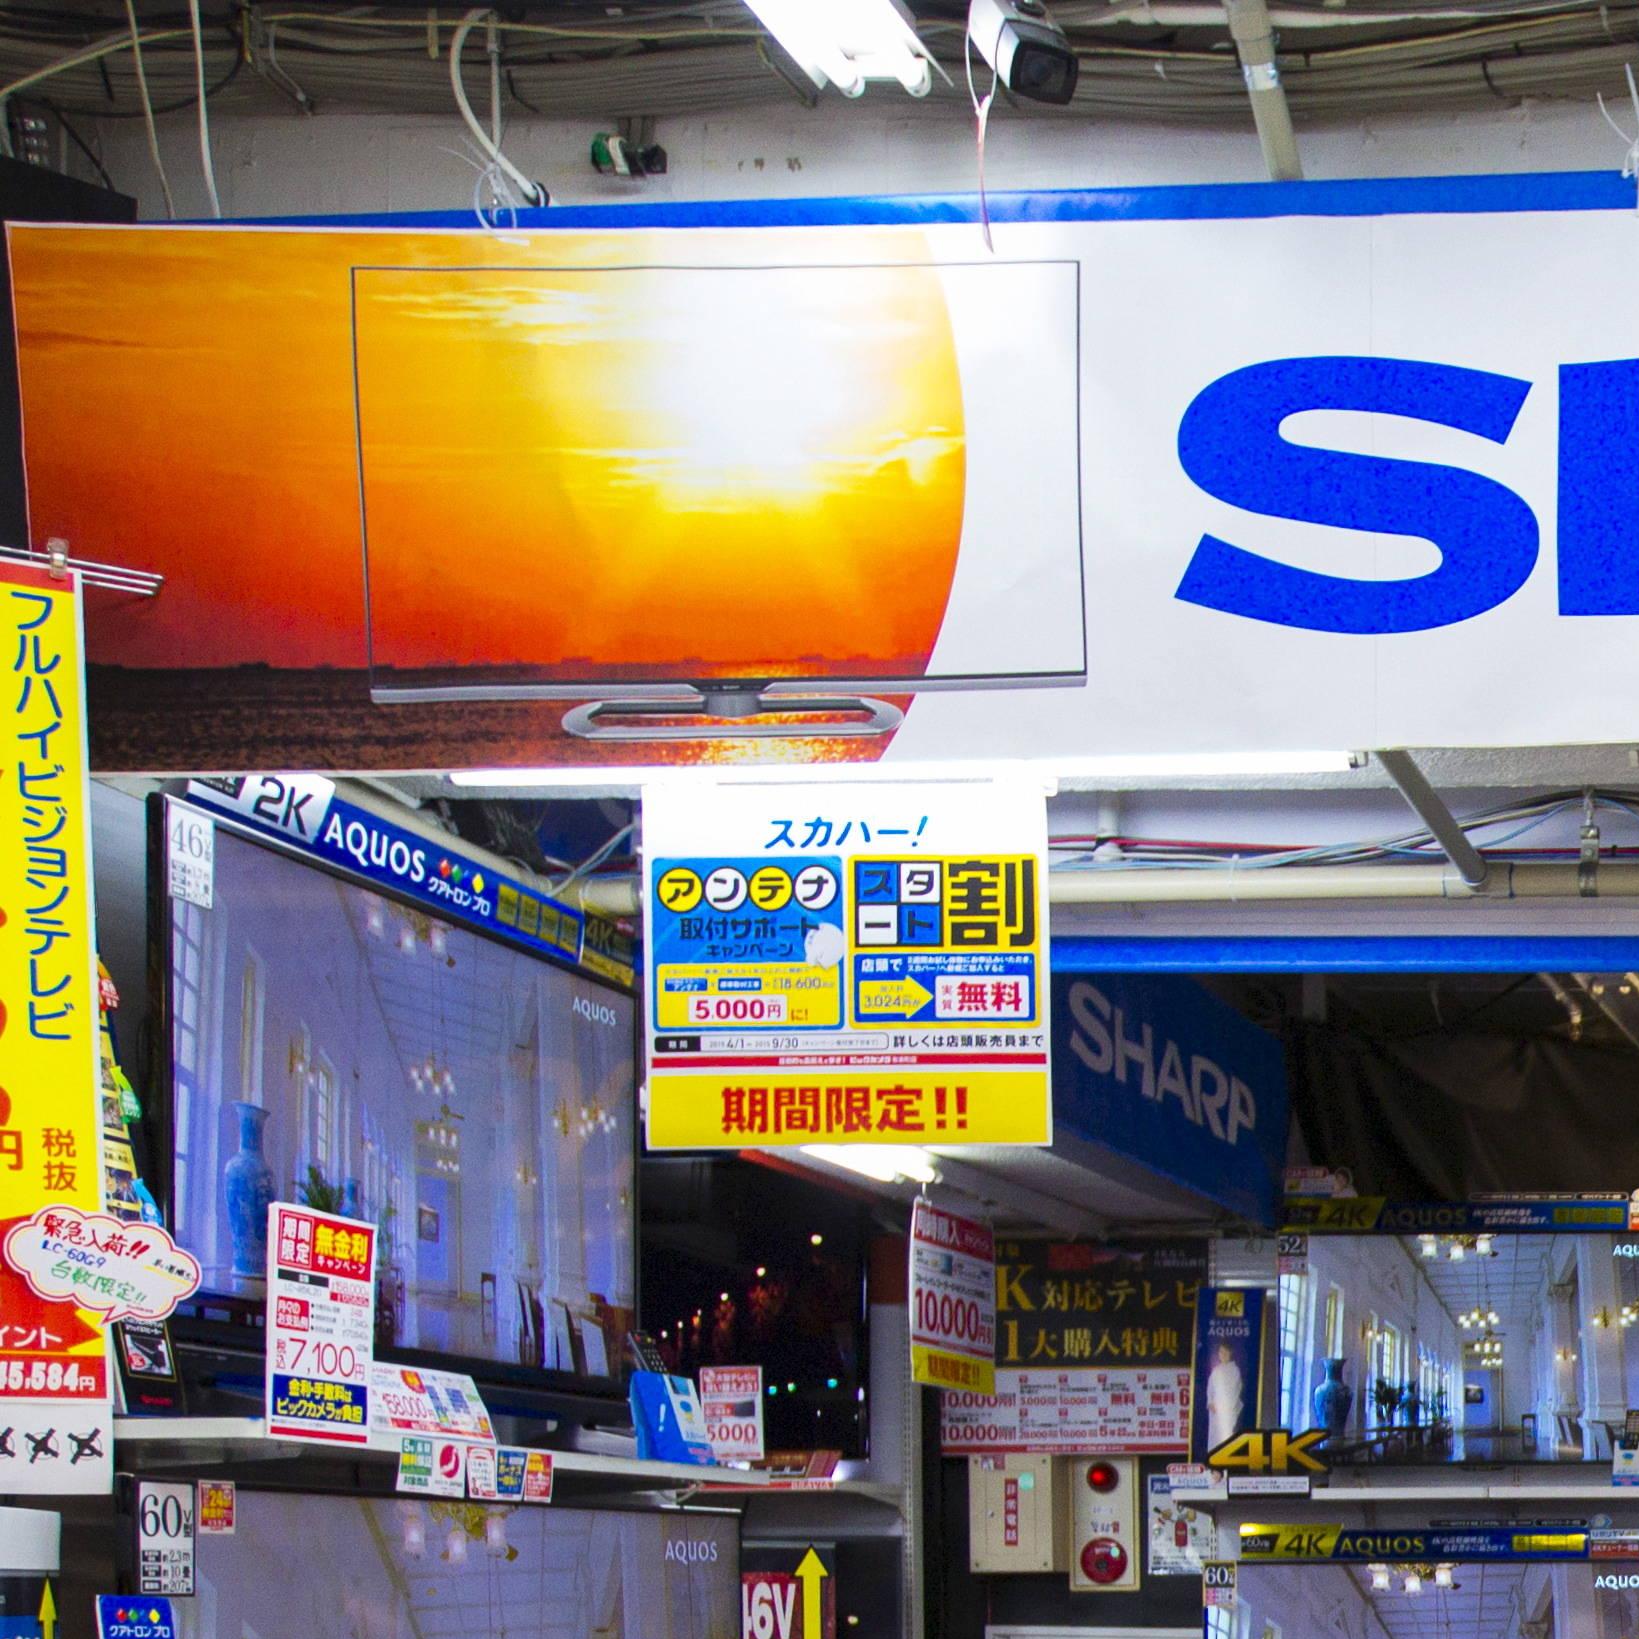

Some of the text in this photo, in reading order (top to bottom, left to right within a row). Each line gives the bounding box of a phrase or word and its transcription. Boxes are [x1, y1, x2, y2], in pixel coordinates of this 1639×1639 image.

[11, 590, 74, 1041] フルハイビジョンテレビ
[250, 776, 315, 836] 2K
[324, 813, 426, 883] AQUOS
[658, 865, 838, 912] アンテナ
[948, 860, 1035, 948] 割
[680, 917, 819, 941] 取付サポート
[706, 943, 794, 958] キャンペーン
[861, 958, 903, 973] 店頭で
[571, 995, 617, 1028] AQUOS
[957, 981, 1022, 1013] 無料
[893, 1033, 1045, 1050] 詳しくは店頭販売員まで
[1068, 981, 1256, 1145] SHARP
[721, 1085, 969, 1134] 期間限定!!
[42, 1127, 77, 1193] 税抜
[1379, 1206, 1467, 1227] AQUOS
[315, 1224, 369, 1263] 無金利
[317, 1257, 365, 1274] キャンペーン
[1216, 1293, 1244, 1317] 4K
[1208, 1324, 1250, 1337] AQUOS
[1208, 1432, 1331, 1471] 4K
[140, 1494, 182, 1538] 60
[665, 1539, 718, 1561] AQUOS
[1283, 1532, 1426, 1556] 4K AQUOS
[109, 1625, 170, 1638] クアトロン プロ
